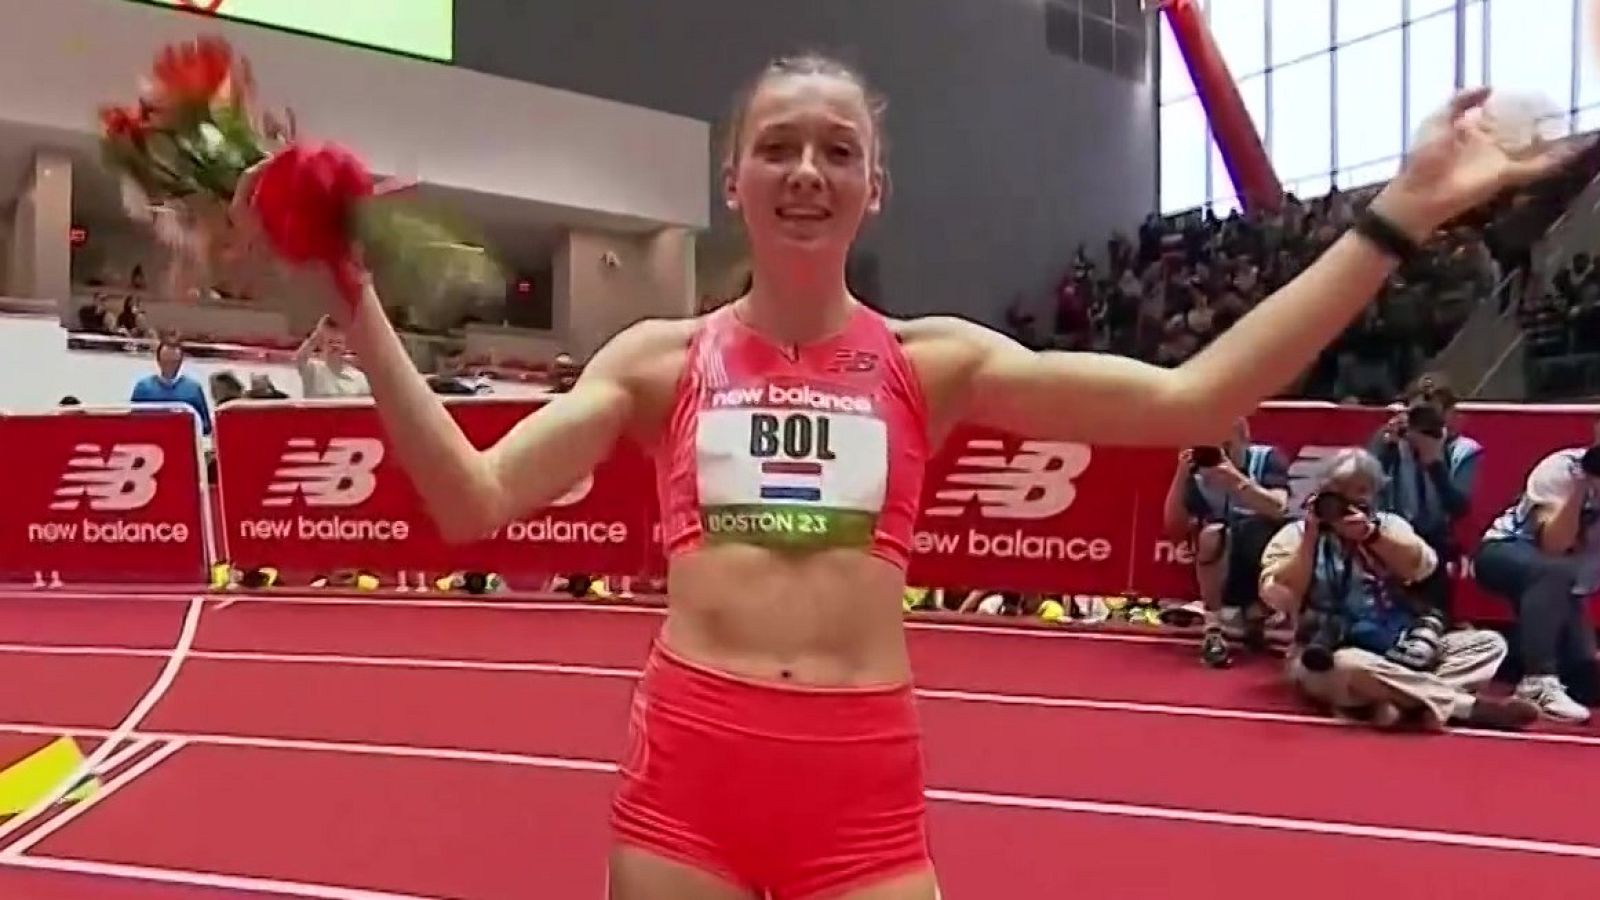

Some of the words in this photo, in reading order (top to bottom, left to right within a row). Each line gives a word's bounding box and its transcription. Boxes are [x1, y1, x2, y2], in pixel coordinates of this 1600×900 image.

[712, 388, 764, 407] new
[768, 384, 872, 411] balance
[750, 413, 836, 460] BOL
[49, 443, 165, 510] NB
[261, 437, 385, 507] NB
[925, 440, 1092, 519] NB
[28, 521, 77, 542] new
[83, 519, 189, 543] balance
[240, 518, 293, 540] new
[298, 515, 409, 541] balance
[507, 516, 628, 543] balance
[707, 511, 793, 534] BOSTON
[797, 514, 829, 533] 23
[912, 530, 959, 554] ew
[968, 529, 1112, 561] balance
[1154, 539, 1197, 564] ne
